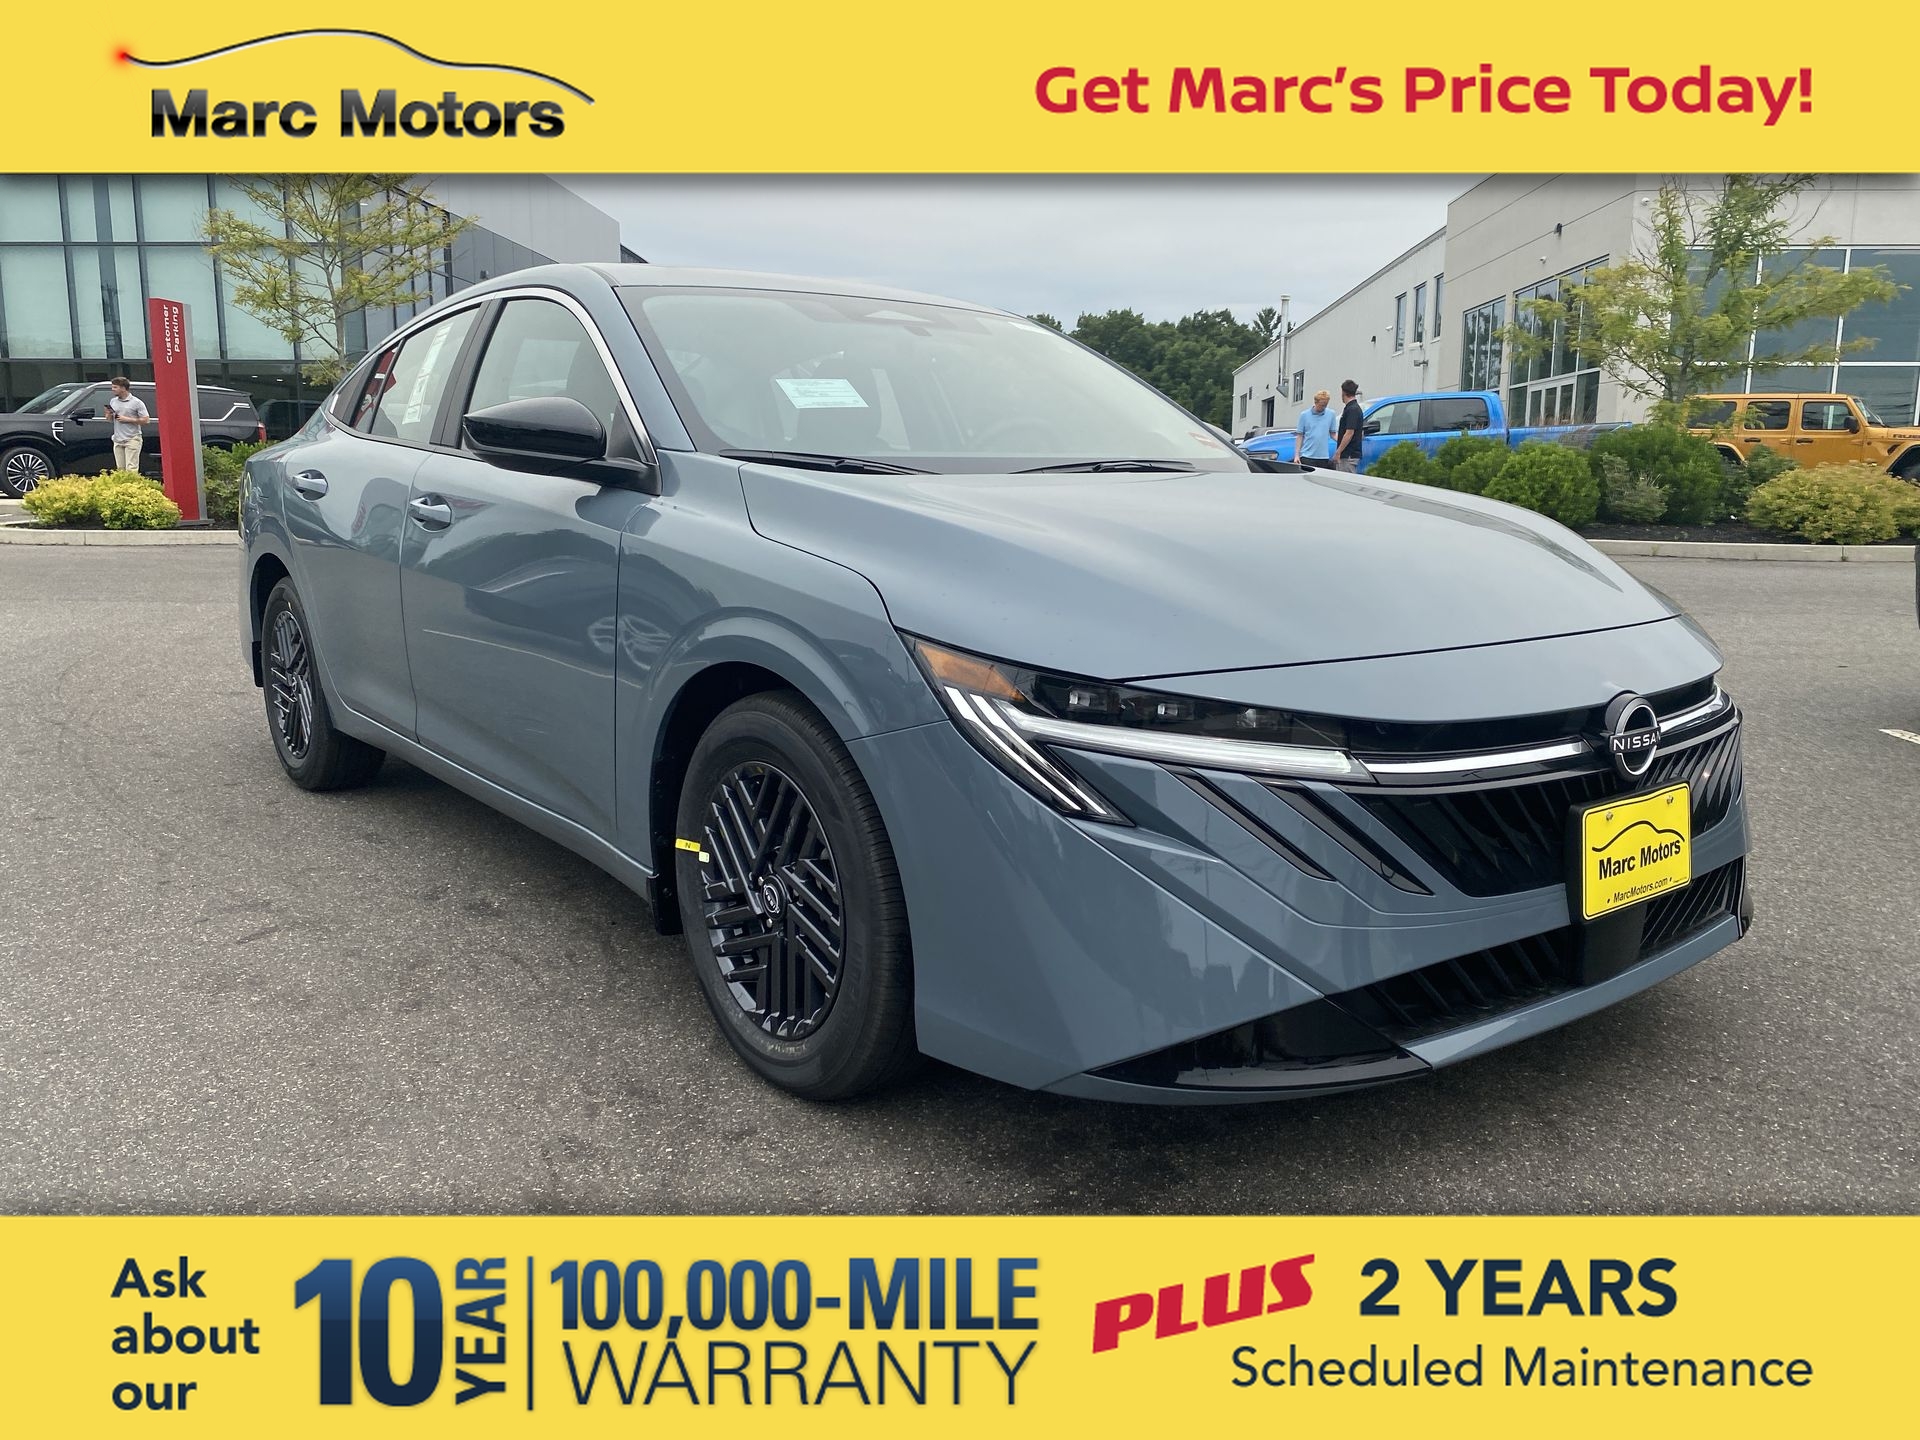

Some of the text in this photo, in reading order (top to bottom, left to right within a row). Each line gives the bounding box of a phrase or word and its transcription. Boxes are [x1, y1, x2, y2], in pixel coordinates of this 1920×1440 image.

[163, 304, 172, 364] Customer
[172, 306, 181, 353] Parking
[1599, 839, 1681, 880] Marc Motors
[1613, 877, 1668, 903] MarcMotors.com
